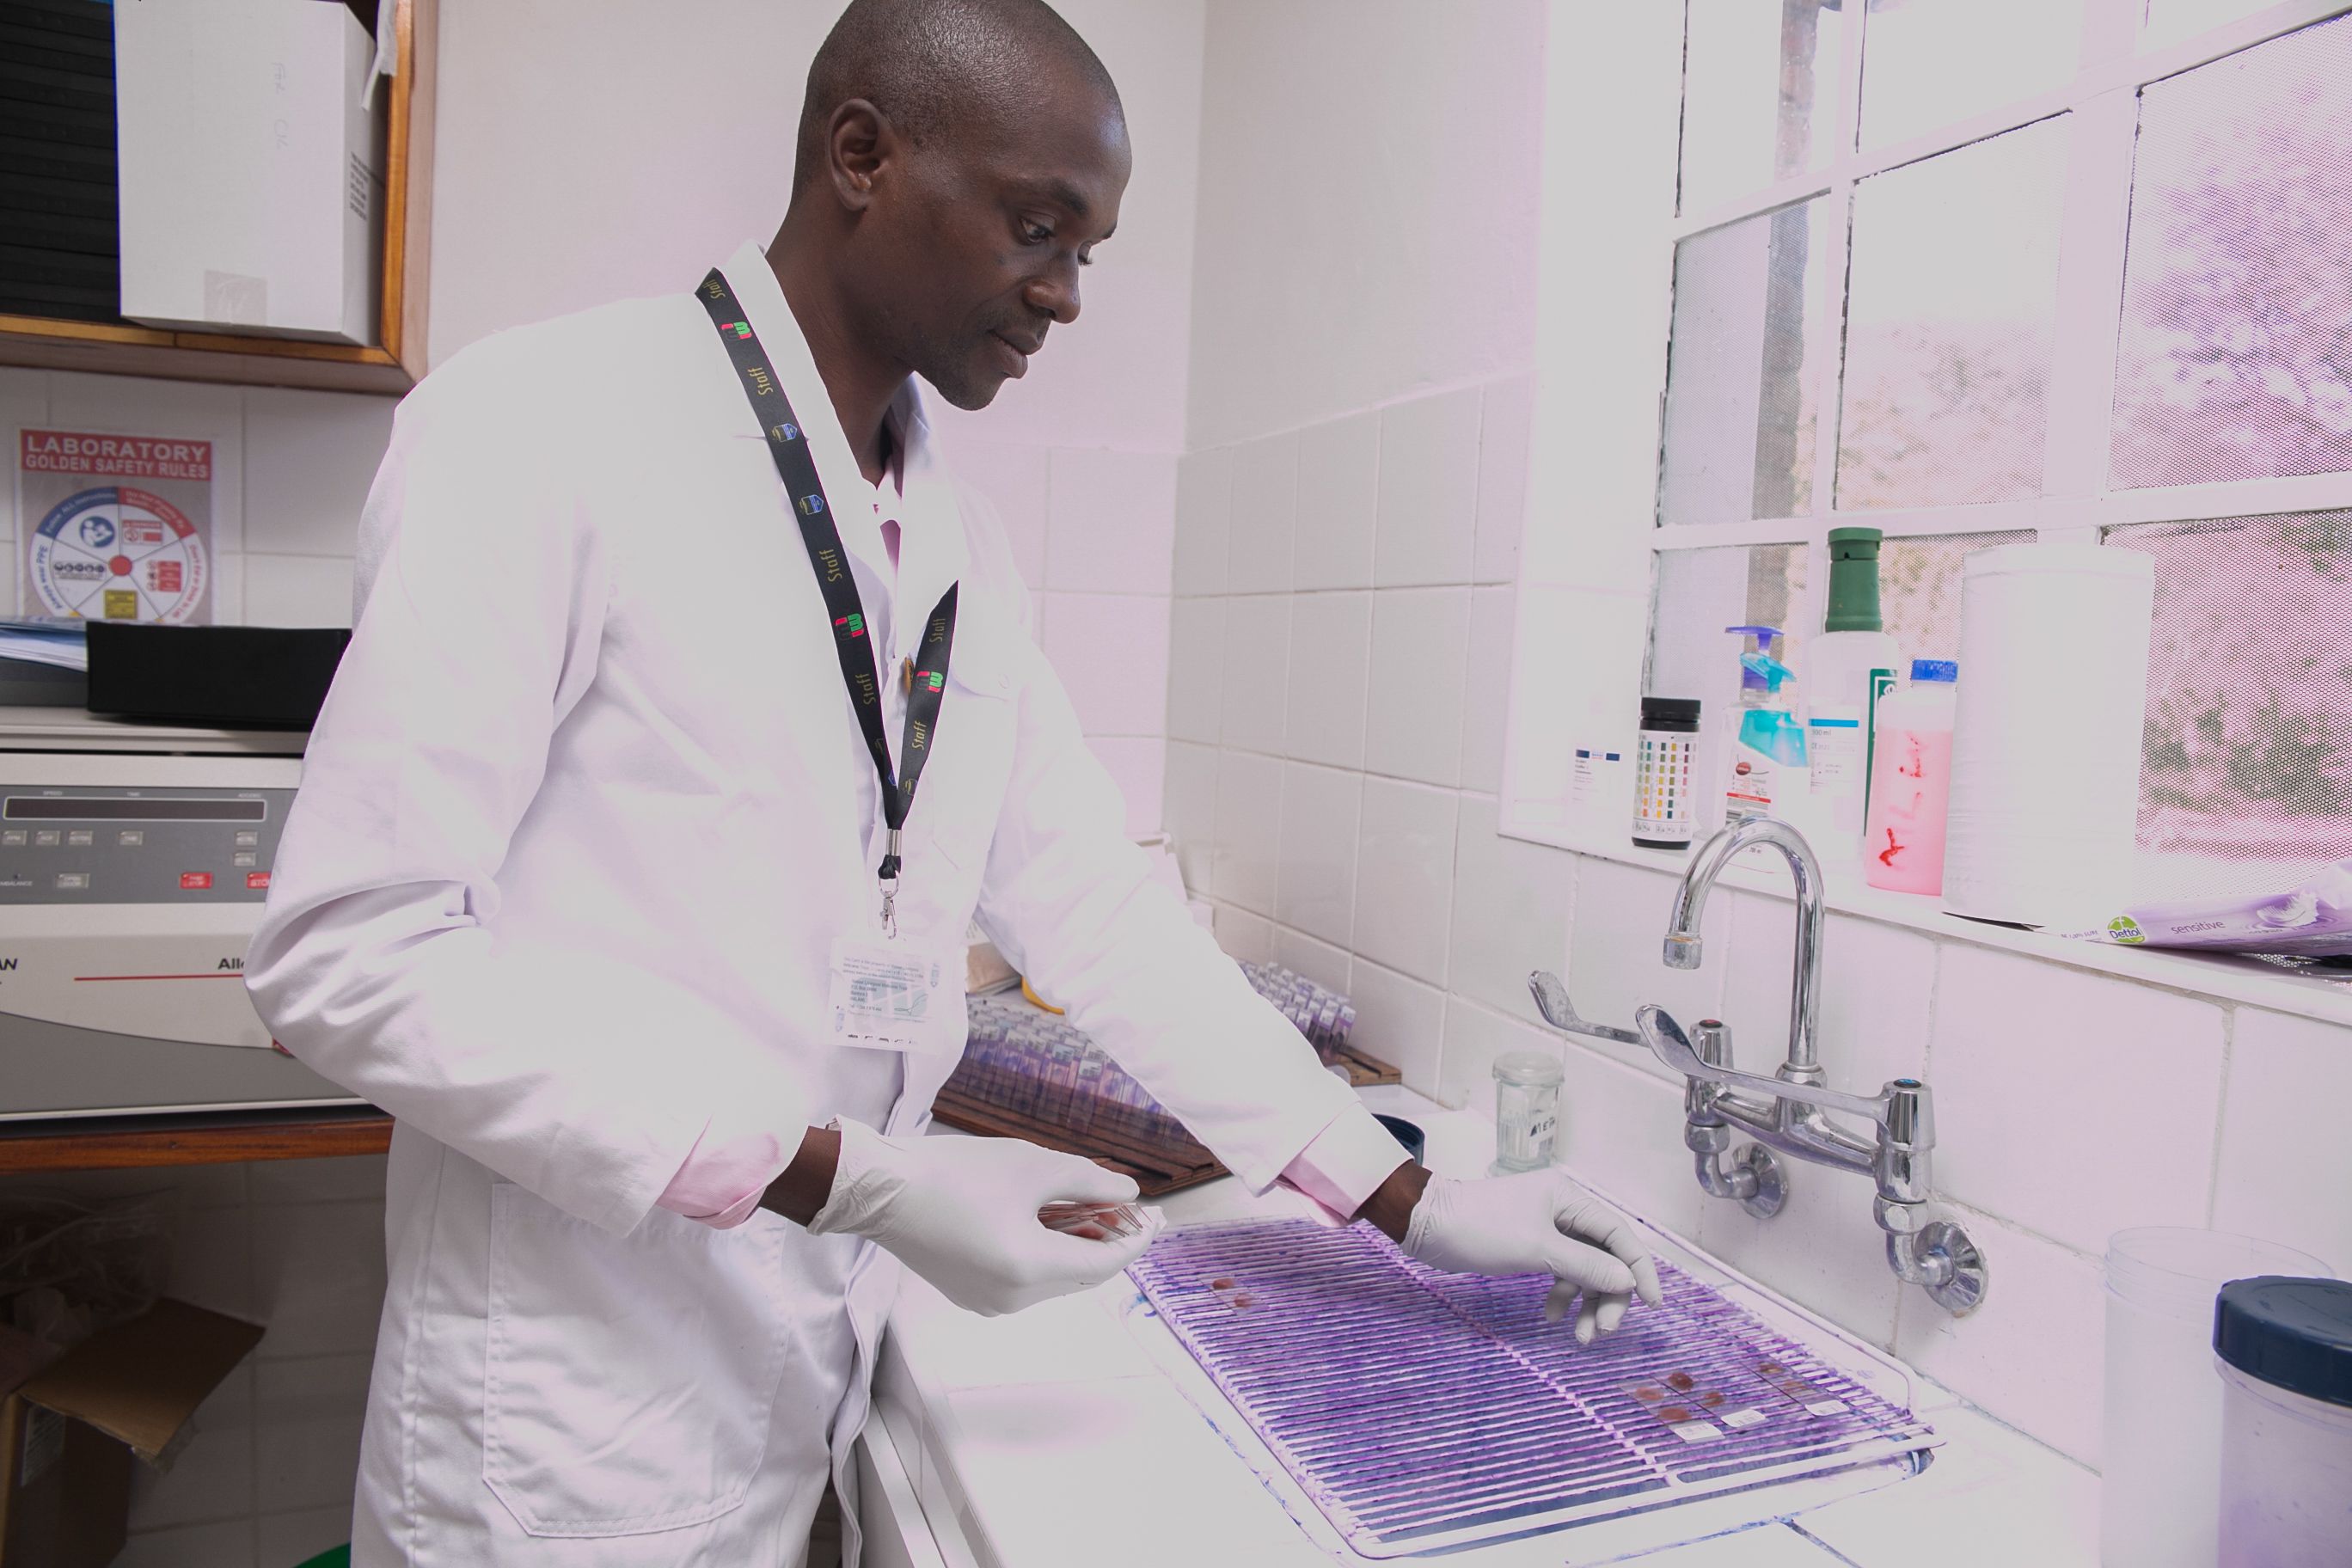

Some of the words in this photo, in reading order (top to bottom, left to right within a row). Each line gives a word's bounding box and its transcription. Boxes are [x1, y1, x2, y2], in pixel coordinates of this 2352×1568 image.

[702, 279, 726, 299] Staff
[748, 367, 774, 395] Staff
[27, 435, 207, 462] LABORATORY
[26, 454, 89, 472] GOLDEN
[95, 459, 154, 475] SAFETY
[159, 462, 208, 479] RULES
[36, 545, 48, 564] PPE
[819, 548, 842, 582] Staff
[929, 617, 946, 643] Staff
[855, 673, 876, 706] Staff
[911, 720, 927, 750] Staff
[2109, 927, 2142, 939] Dettol
[2171, 920, 2226, 934] sensitive
